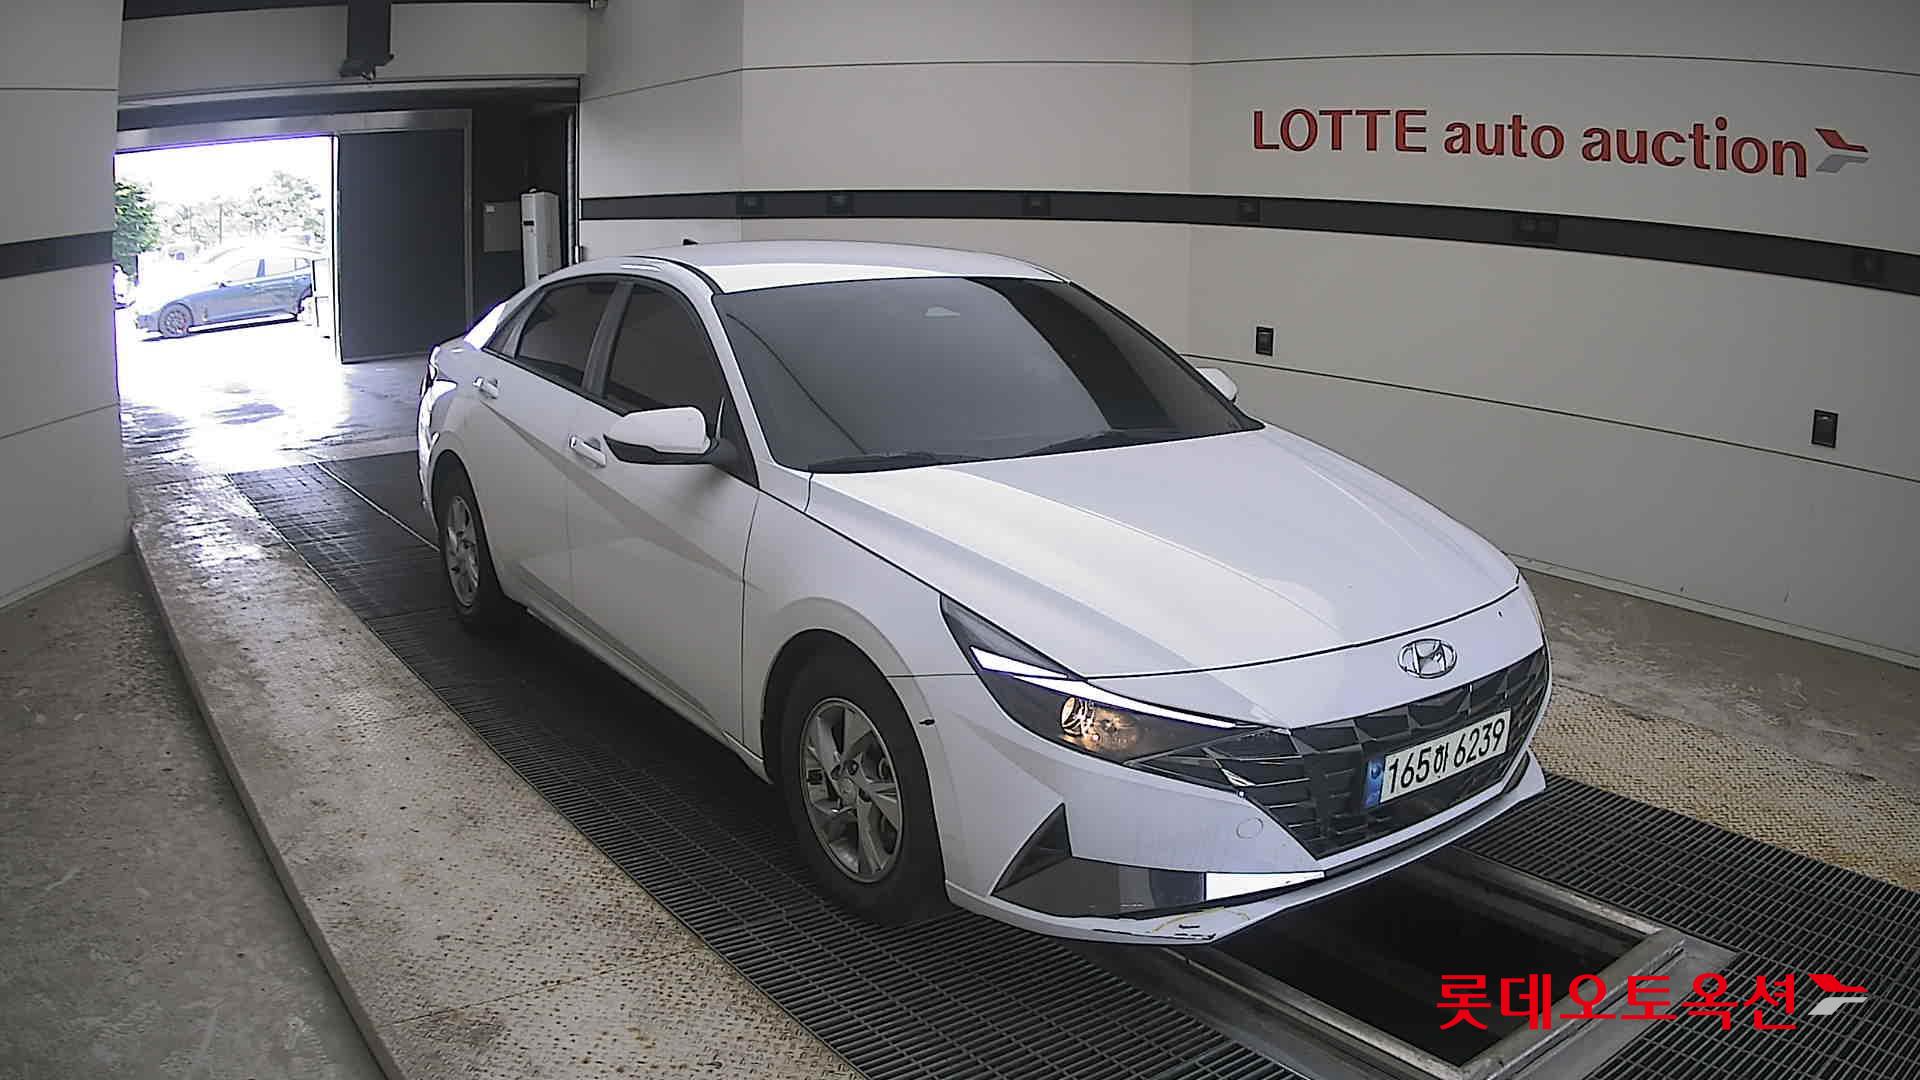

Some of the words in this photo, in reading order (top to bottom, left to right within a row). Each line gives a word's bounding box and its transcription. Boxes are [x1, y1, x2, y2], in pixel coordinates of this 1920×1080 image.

[1252, 109, 1427, 152] LOTTE
[1444, 115, 1566, 158] auto
[1581, 117, 1808, 178] auction
[1389, 742, 1449, 793] 165하
[1453, 718, 1506, 768] 6239
